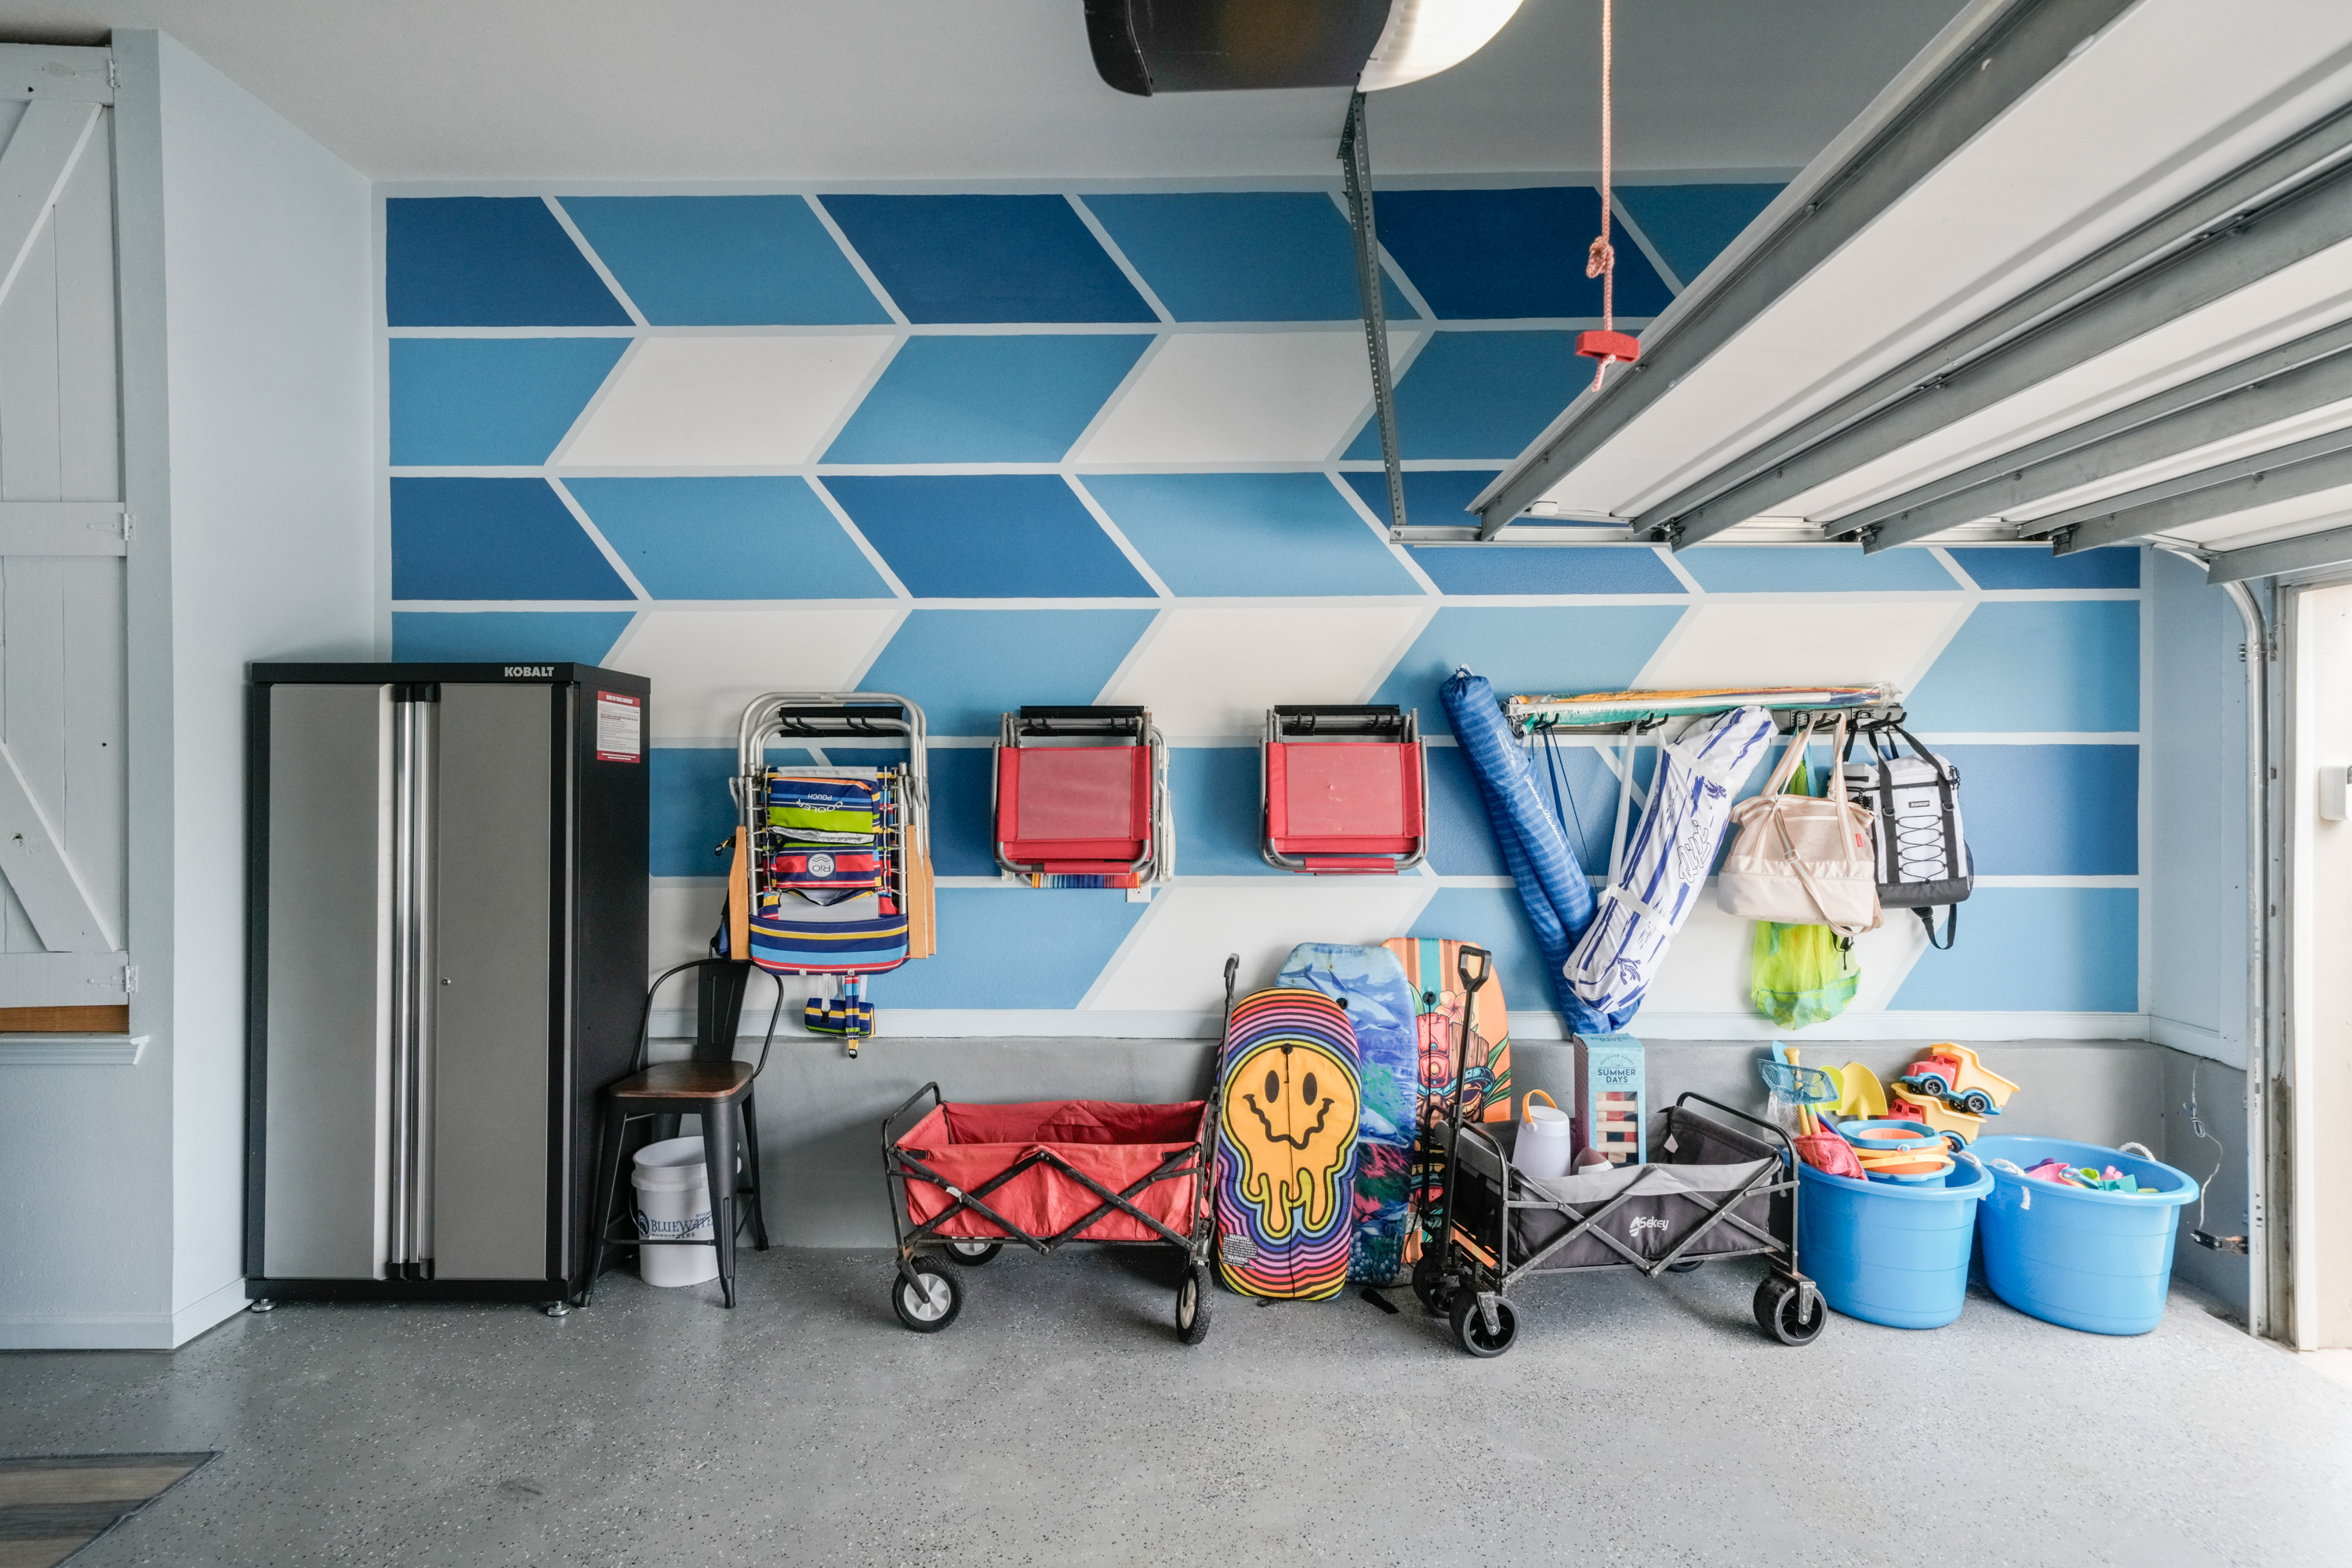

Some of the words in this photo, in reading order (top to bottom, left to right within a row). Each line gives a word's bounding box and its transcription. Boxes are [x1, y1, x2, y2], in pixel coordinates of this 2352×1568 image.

[504, 666, 554, 677] KOBALT
[1524, 775, 1544, 809] Tommy
[797, 798, 844, 813] COOLER
[1600, 1054, 1620, 1065] OUTDOOR
[1621, 1055, 1635, 1065] GAMES
[651, 1217, 713, 1232] BLUEWATE
[1639, 1216, 1669, 1231] Sekey
